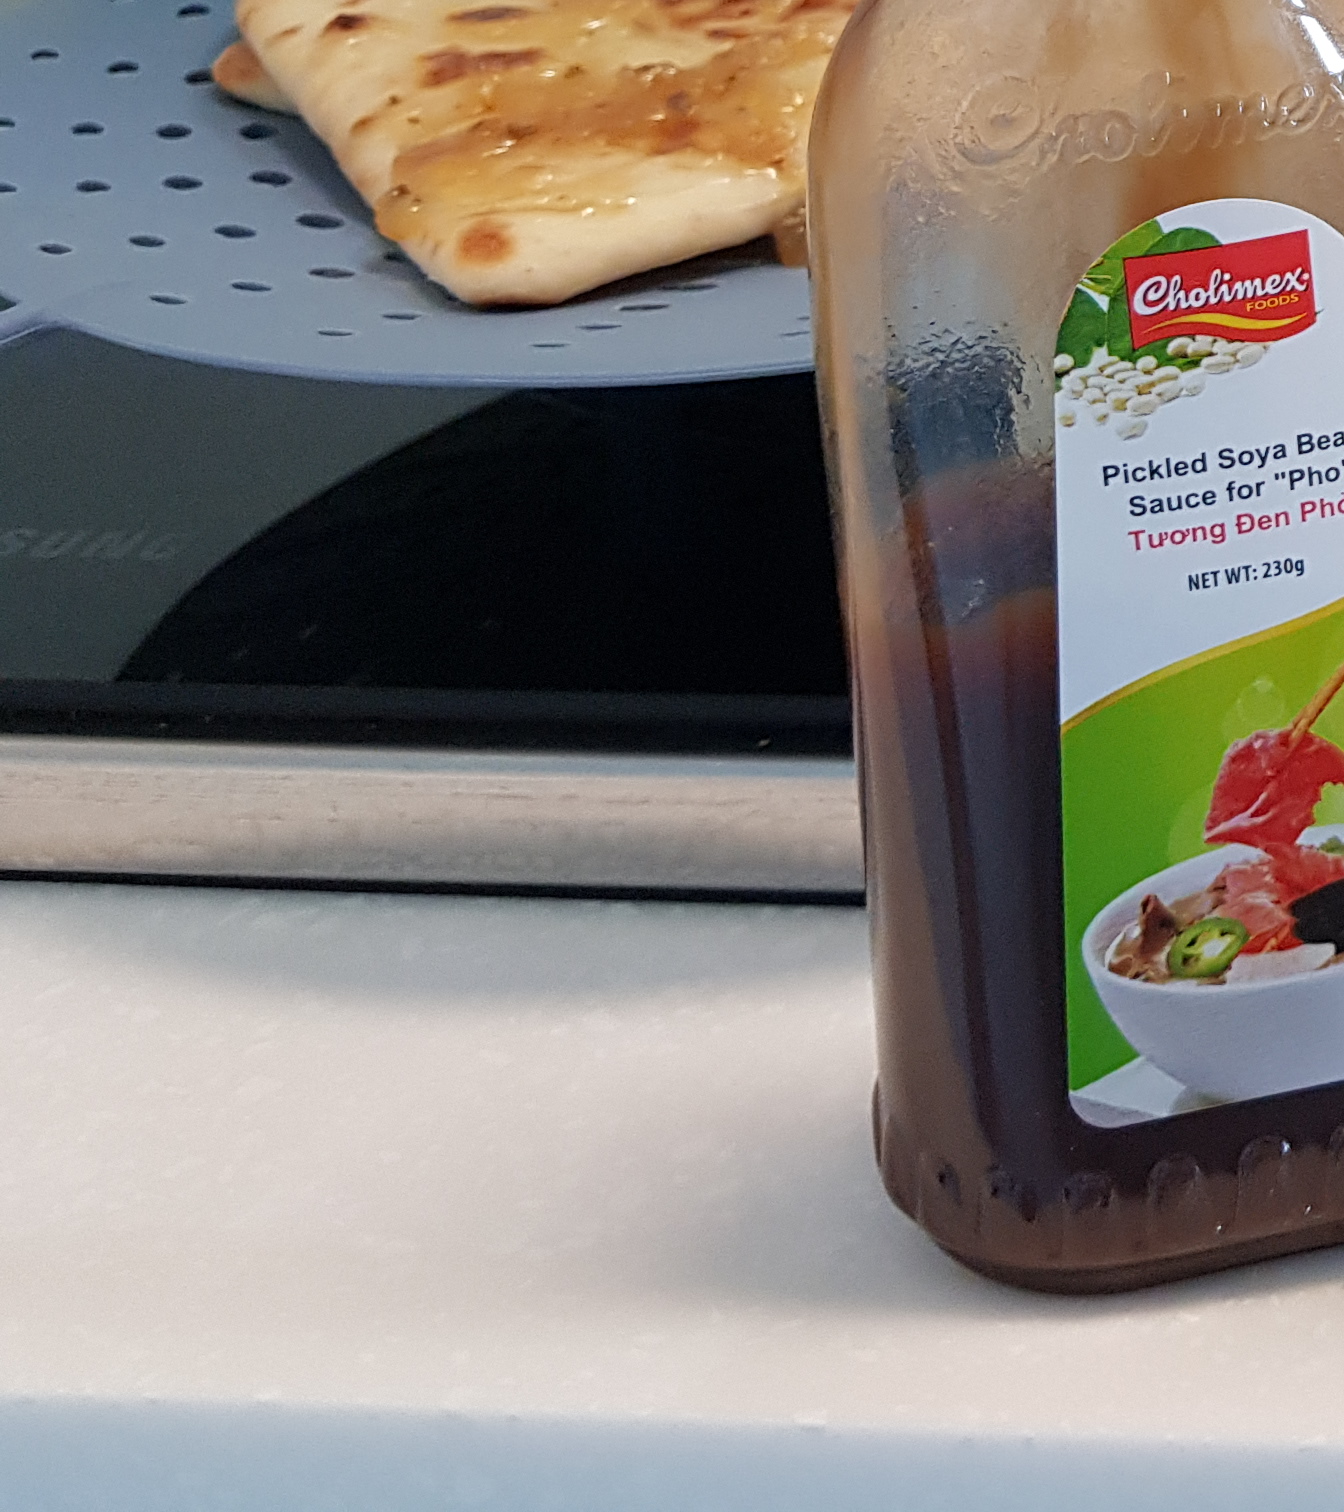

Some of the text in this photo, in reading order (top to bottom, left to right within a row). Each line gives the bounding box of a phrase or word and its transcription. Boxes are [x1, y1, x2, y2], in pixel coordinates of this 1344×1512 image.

[1133, 267, 1304, 316] Cholimex
[1245, 292, 1300, 313] FOODS
[1102, 453, 1208, 487] Pickled
[1217, 442, 1288, 473] Soya
[1128, 484, 1217, 518] Sauce
[1225, 480, 1266, 503] for
[1127, 519, 1227, 553] Tương
[1235, 509, 1291, 536] Đen
[1187, 558, 1306, 592] NET WT: 230g
